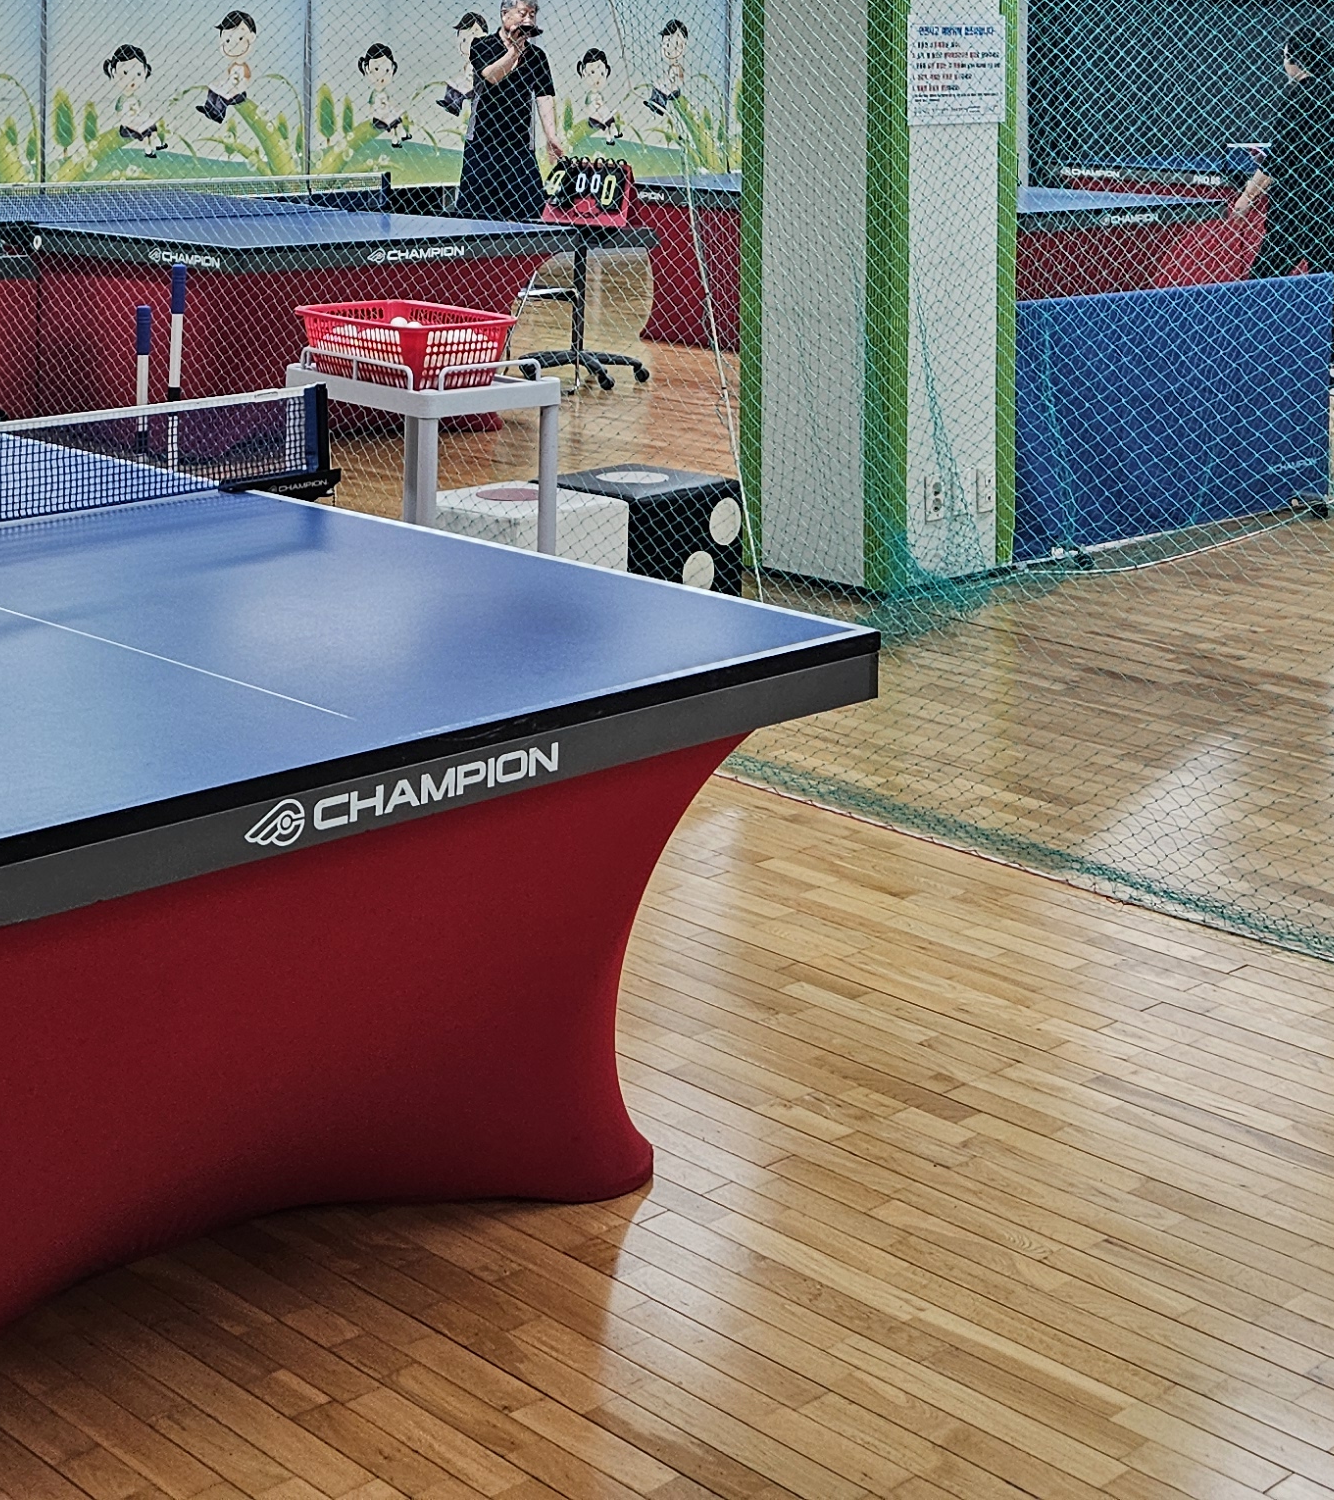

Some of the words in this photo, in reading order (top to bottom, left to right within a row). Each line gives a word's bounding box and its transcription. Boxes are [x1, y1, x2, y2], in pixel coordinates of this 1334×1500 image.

[639, 191, 664, 201] PION
[162, 251, 220, 268] CHAMPION
[387, 246, 465, 261] CHAMPION
[279, 479, 327, 492] CHAMPION
[313, 741, 559, 831] CHAMPION
